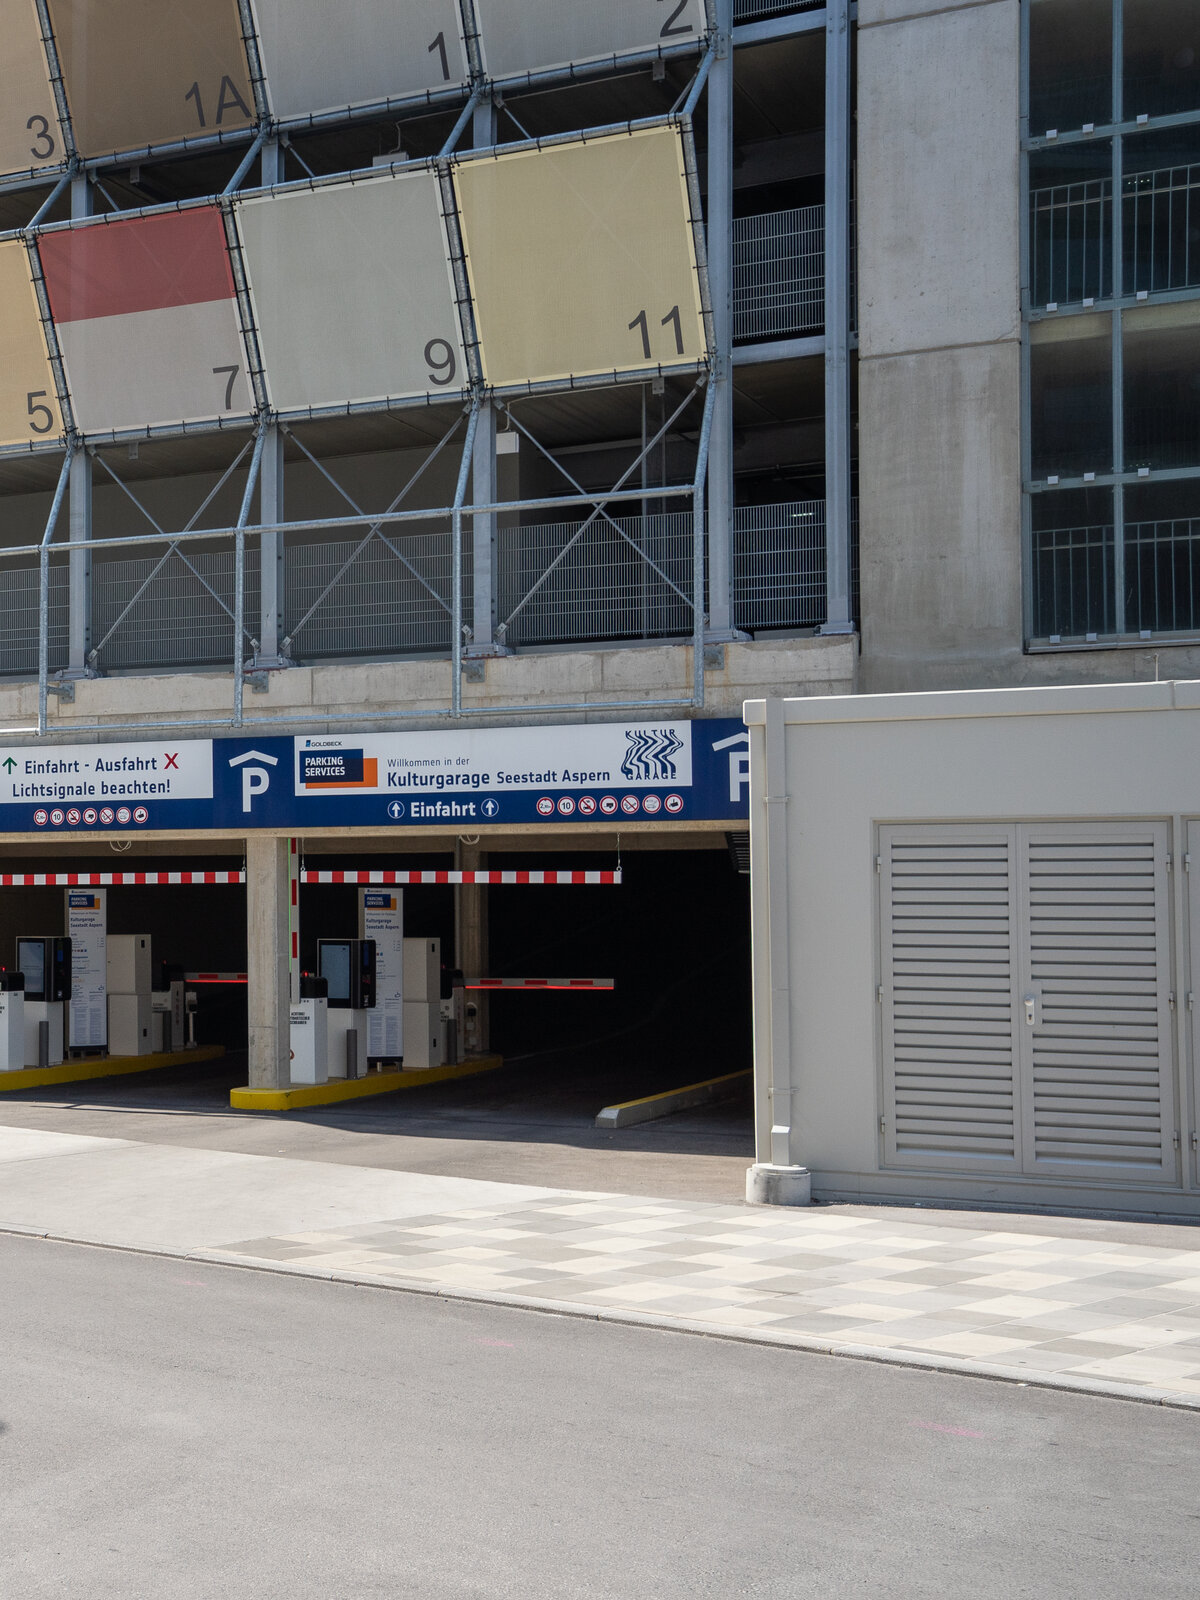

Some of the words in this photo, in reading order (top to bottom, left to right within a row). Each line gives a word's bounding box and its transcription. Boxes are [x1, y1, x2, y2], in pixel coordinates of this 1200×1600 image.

[657, 0, 693, 37] 2
[428, 31, 450, 80] 1
[185, 75, 252, 127] 1A
[26, 114, 55, 160] 3
[628, 305, 684, 359] 11
[424, 338, 456, 386] 9
[212, 364, 240, 410] 7
[27, 390, 54, 434] 5
[25, 759, 80, 775] Einfahrt
[95, 757, 157, 772] Ausfahrt
[305, 756, 343, 766] PARKING
[305, 766, 345, 777] SERVICES
[387, 758, 441, 768] Willkommen
[444, 757, 452, 766] in
[456, 757, 470, 766] der
[387, 771, 490, 788] Kulturgarage
[497, 770, 558, 784] Seestadt
[562, 769, 610, 785] Aspern
[12, 782, 96, 799] Lichtsignale
[101, 779, 171, 795] beachten!
[242, 767, 270, 813] P
[561, 802, 571, 810] 10
[410, 801, 476, 818] Einfahrt
